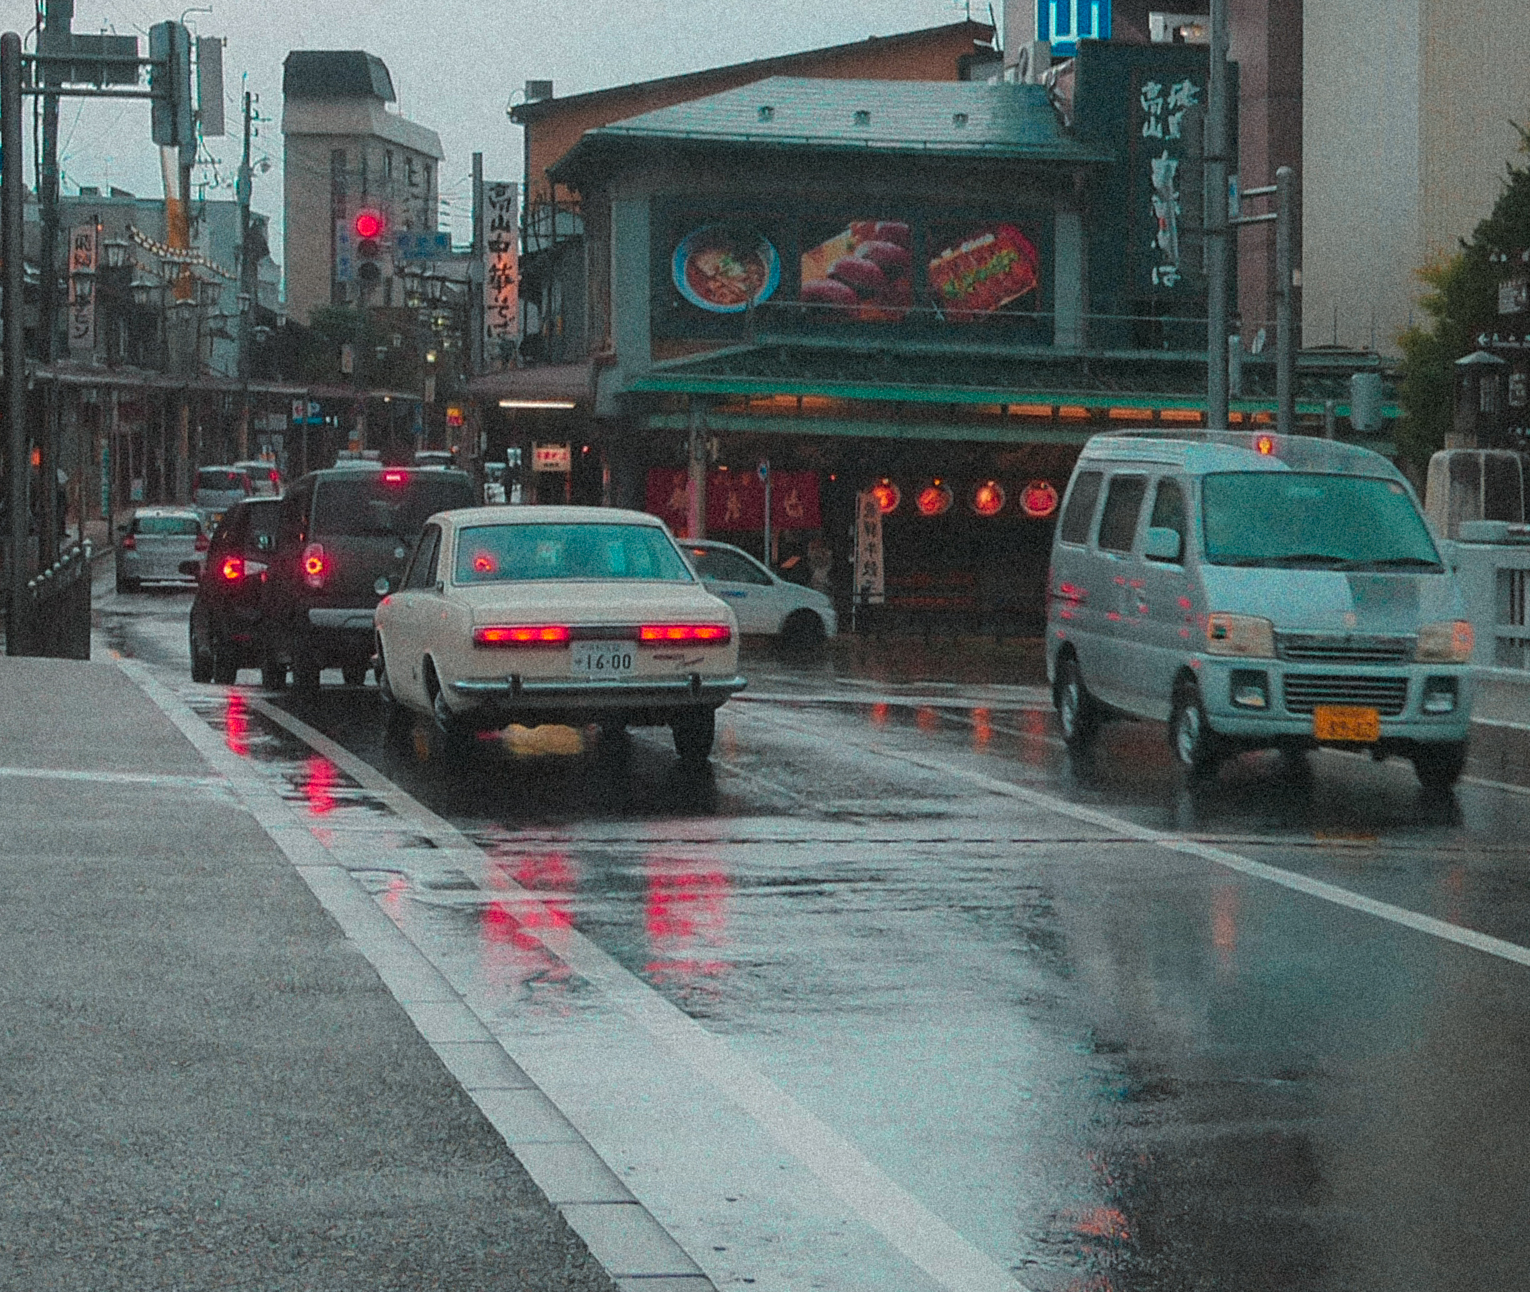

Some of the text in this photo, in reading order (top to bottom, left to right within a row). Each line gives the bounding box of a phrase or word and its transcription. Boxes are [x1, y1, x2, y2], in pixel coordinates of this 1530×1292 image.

[488, 182, 515, 340] 高山中華そば
